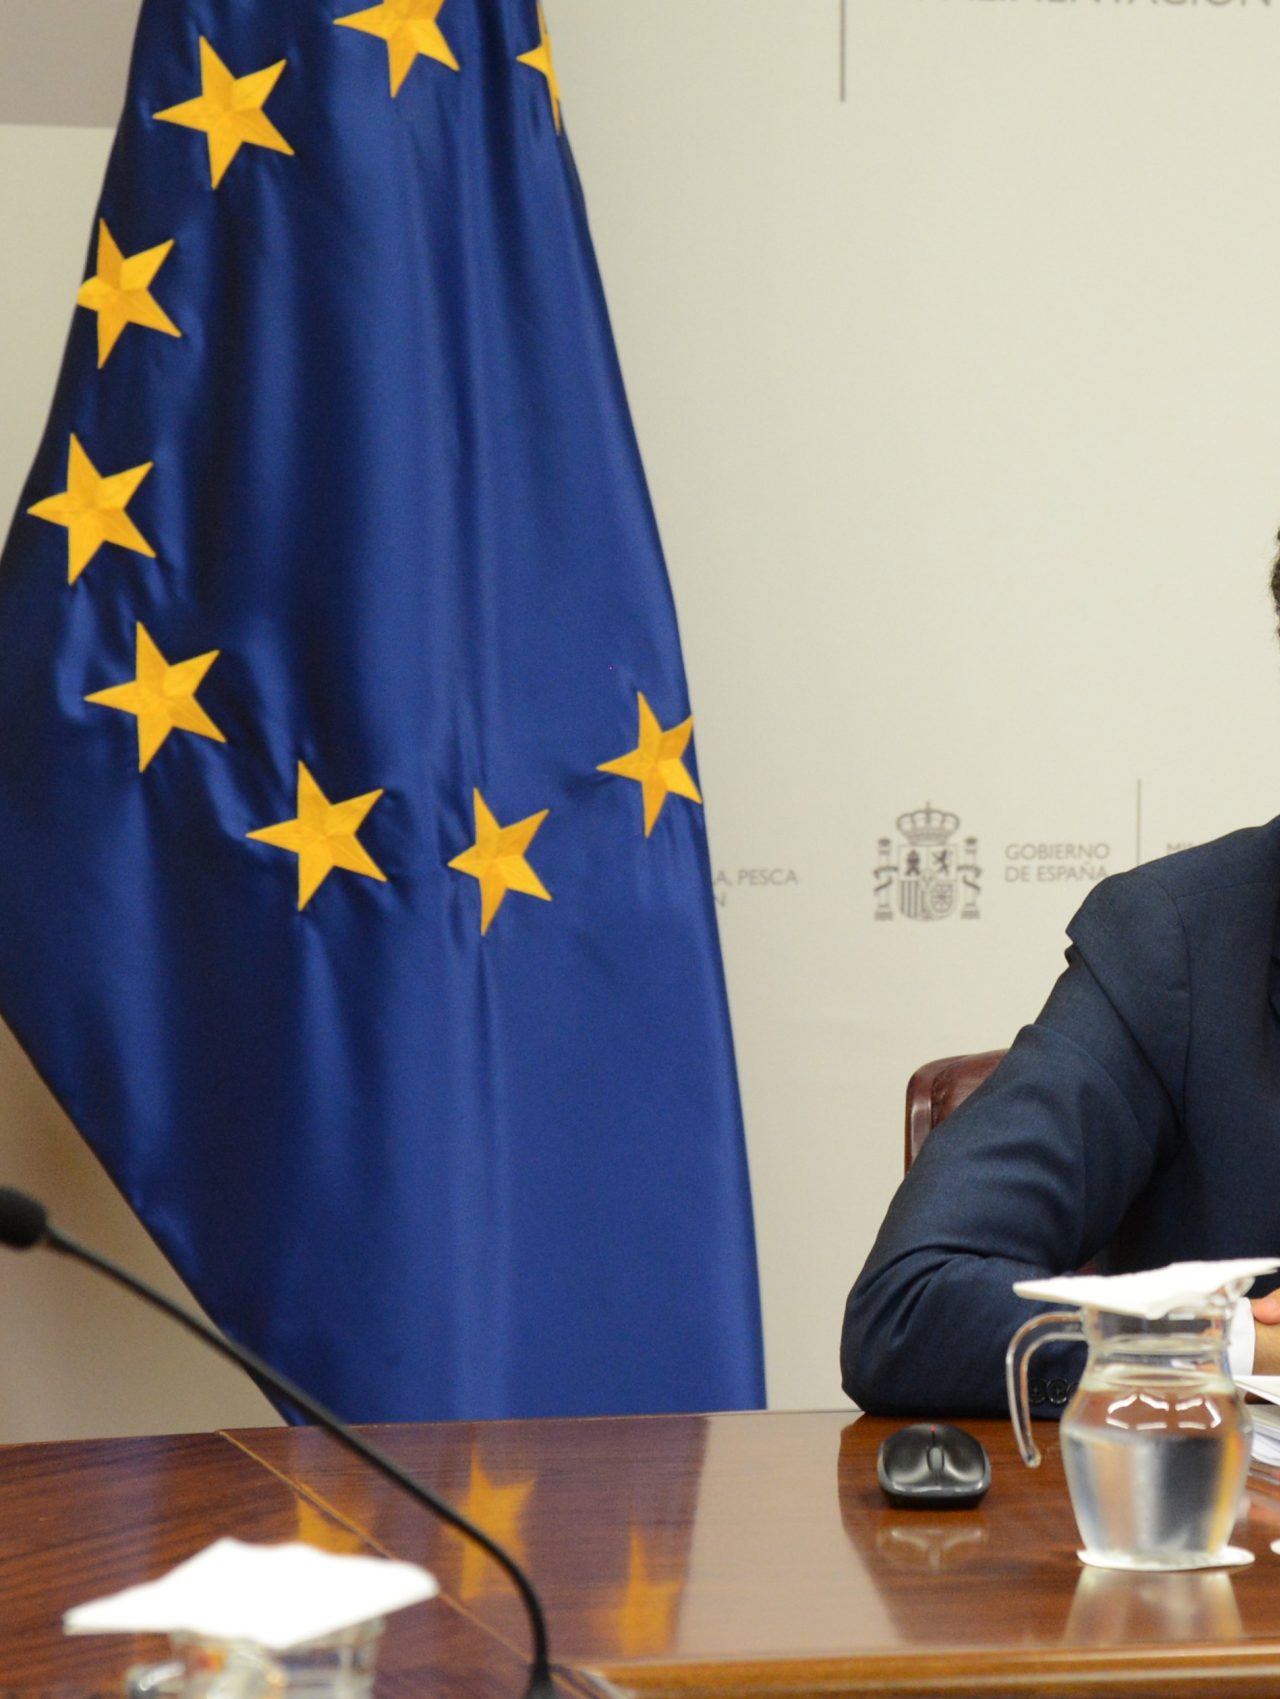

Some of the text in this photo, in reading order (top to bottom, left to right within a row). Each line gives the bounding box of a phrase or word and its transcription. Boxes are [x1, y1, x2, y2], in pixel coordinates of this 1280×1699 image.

[1004, 842, 1111, 860] GOBIERNO
[737, 867, 800, 886] PESCA
[1004, 865, 1031, 883] DE
